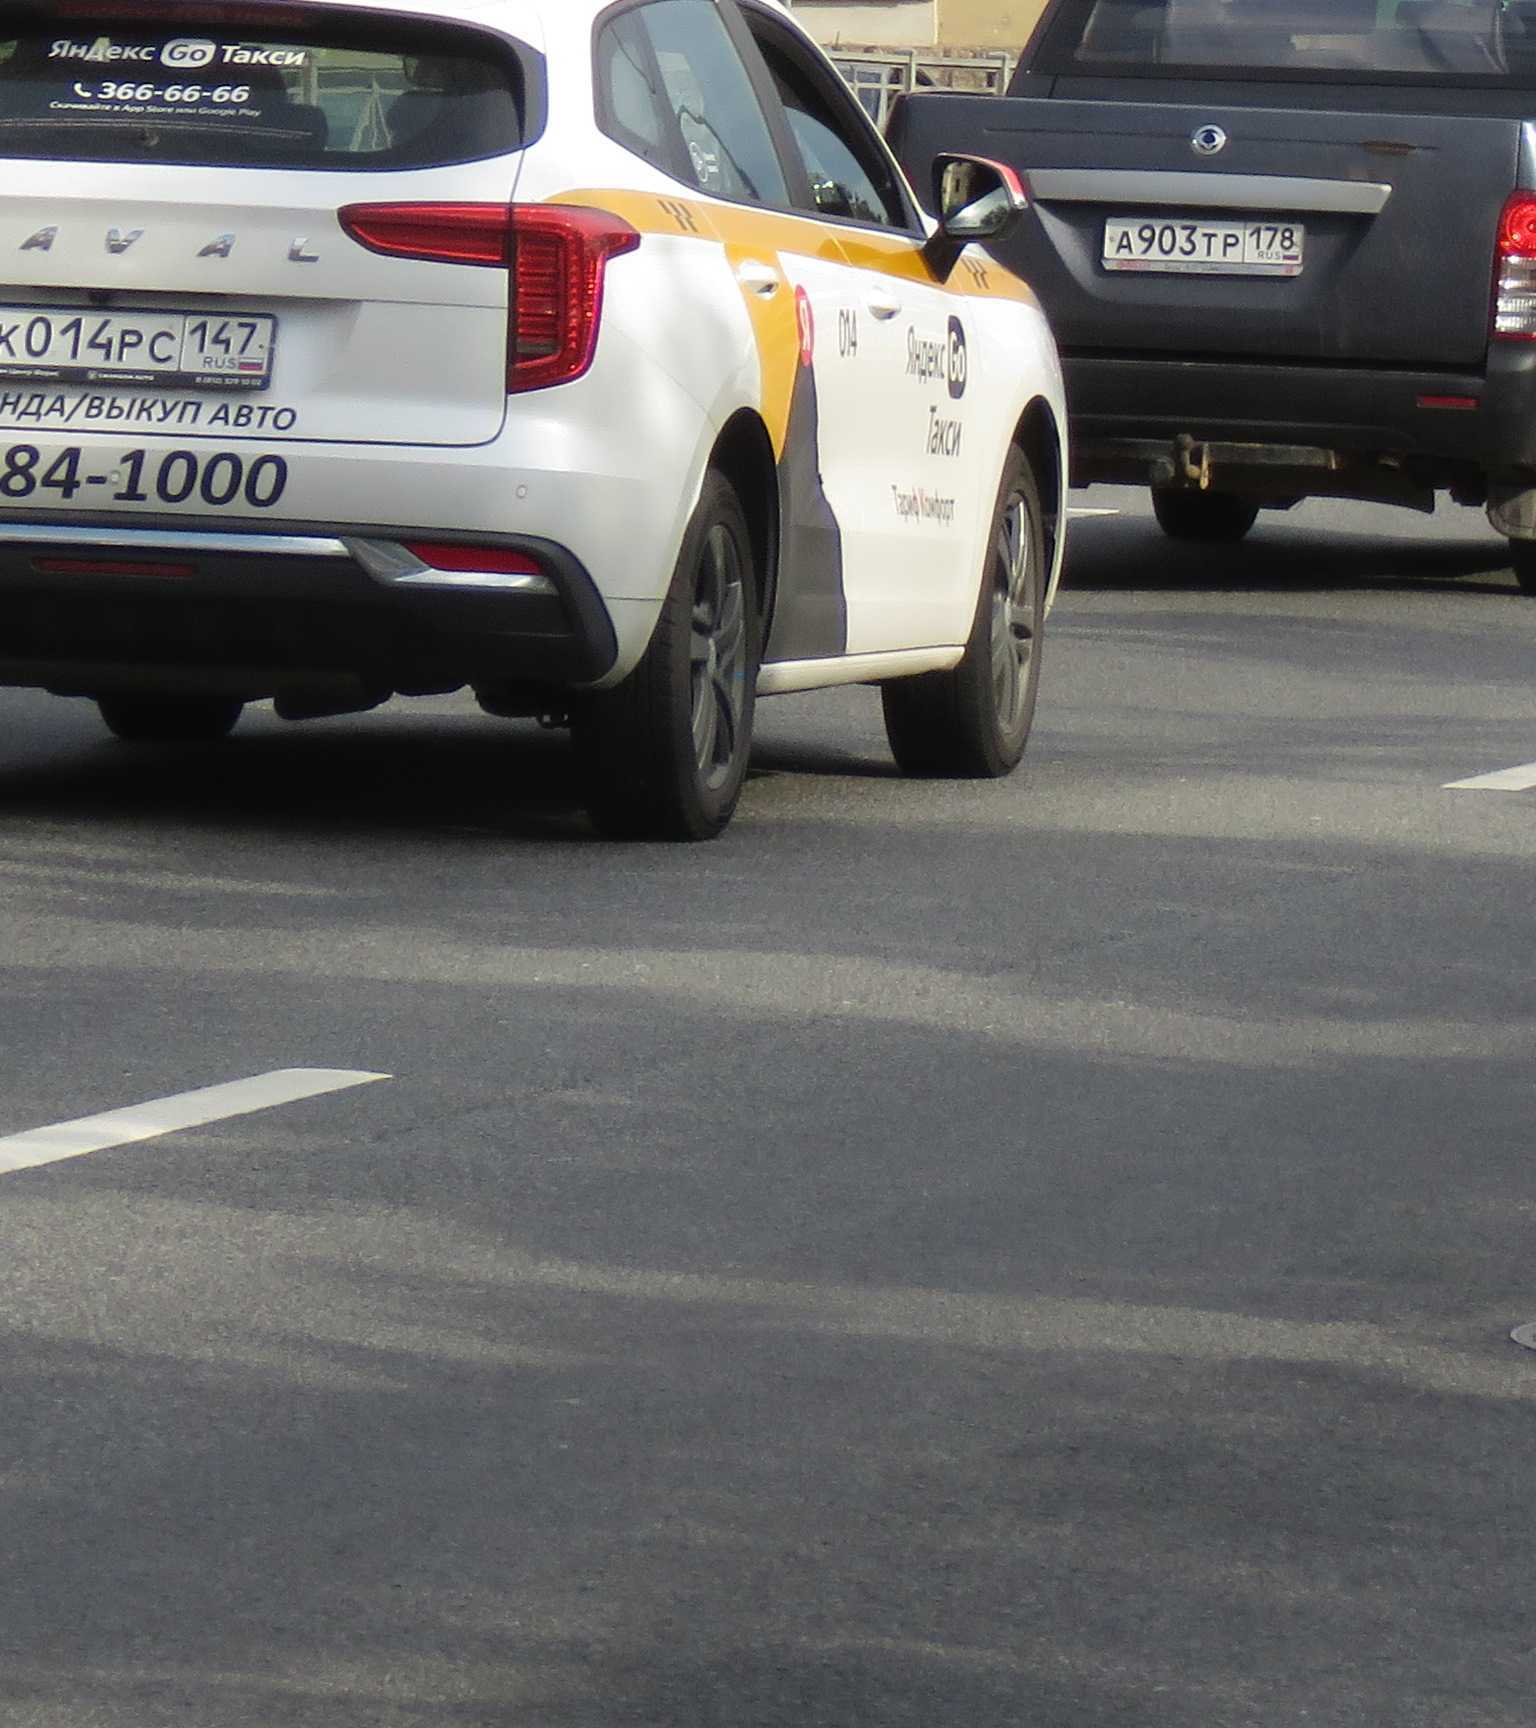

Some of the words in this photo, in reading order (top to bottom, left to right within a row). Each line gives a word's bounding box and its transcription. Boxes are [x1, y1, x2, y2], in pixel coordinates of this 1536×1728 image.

[48, 38, 155, 63] Яндекс
[164, 41, 212, 64] Go
[222, 44, 307, 65] Такси
[98, 82, 250, 103] 366-66-66
[1116, 224, 1239, 257] А903ТР
[1249, 226, 1295, 251] 178
[189, 320, 258, 355] 147
[202, 356, 237, 370] RUS
[906, 325, 946, 385] Яндекс
[208, 403, 297, 431] АВТО
[927, 405, 963, 457] Такси
[0, 444, 288, 508] 84-1000
